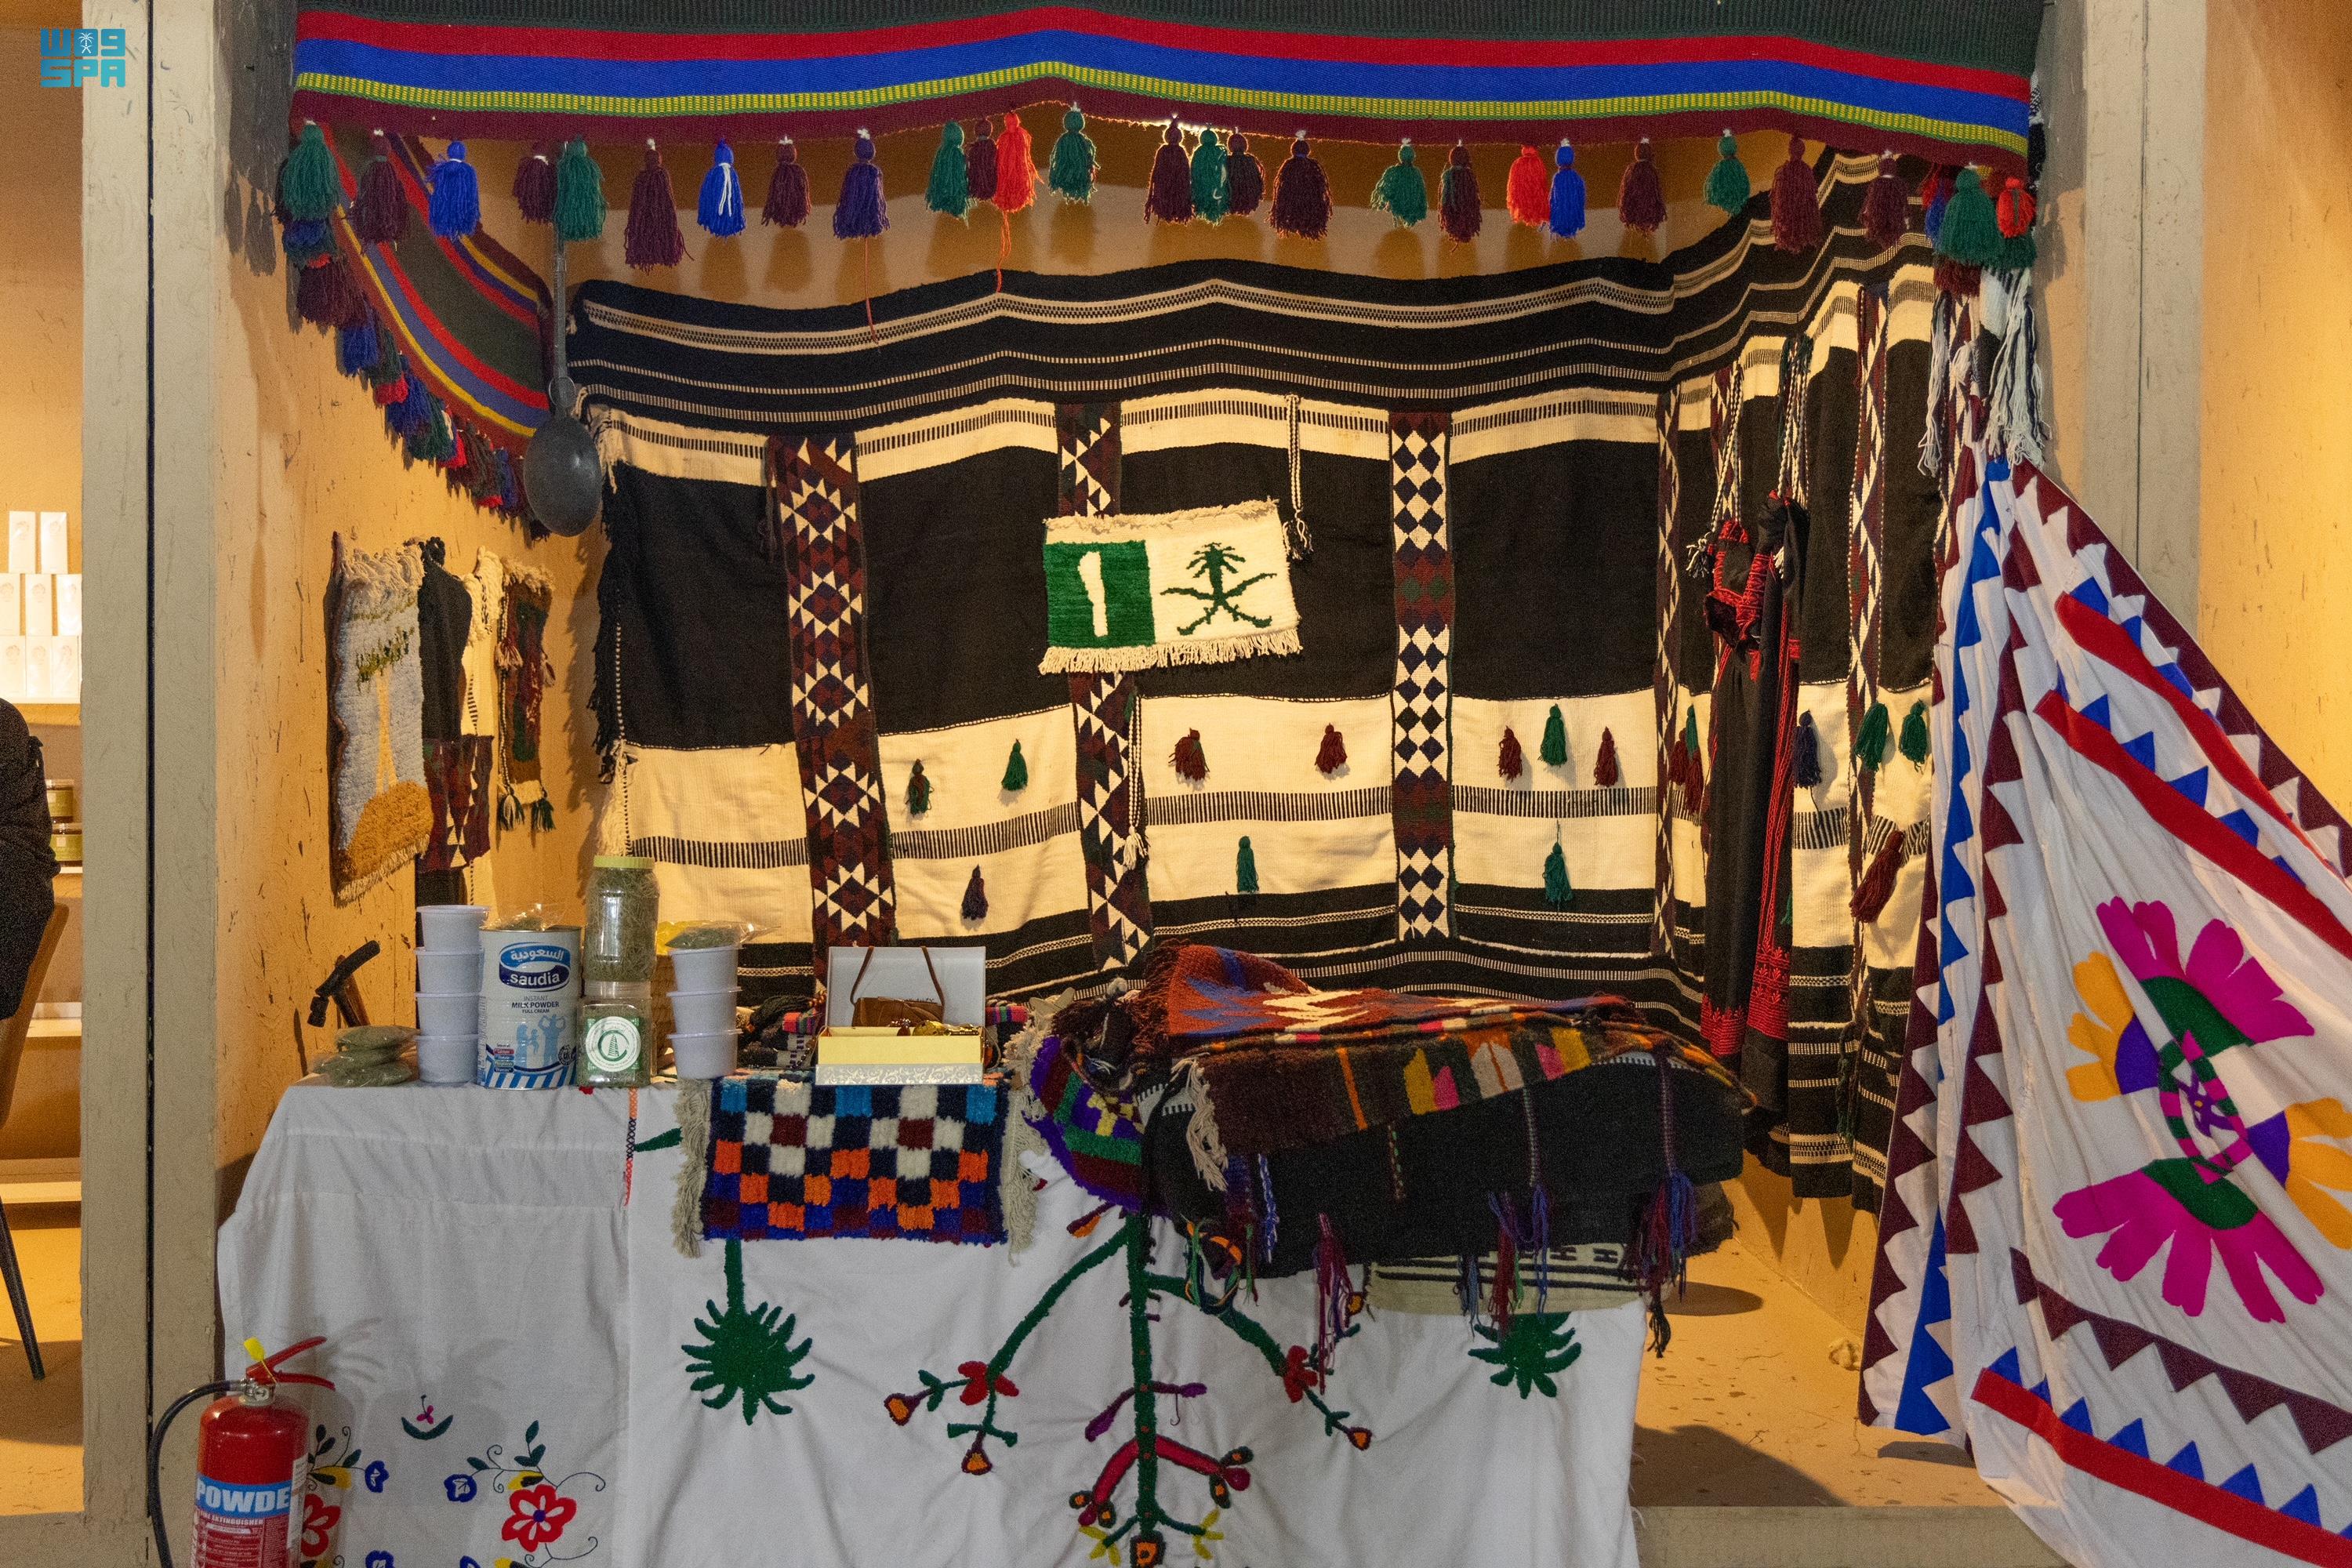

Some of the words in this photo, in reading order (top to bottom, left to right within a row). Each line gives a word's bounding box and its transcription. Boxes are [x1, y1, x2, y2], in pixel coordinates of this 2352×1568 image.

[510, 949, 564, 962] السعودية
[510, 972, 560, 985] saudia
[197, 1478, 291, 1512] POWDE
